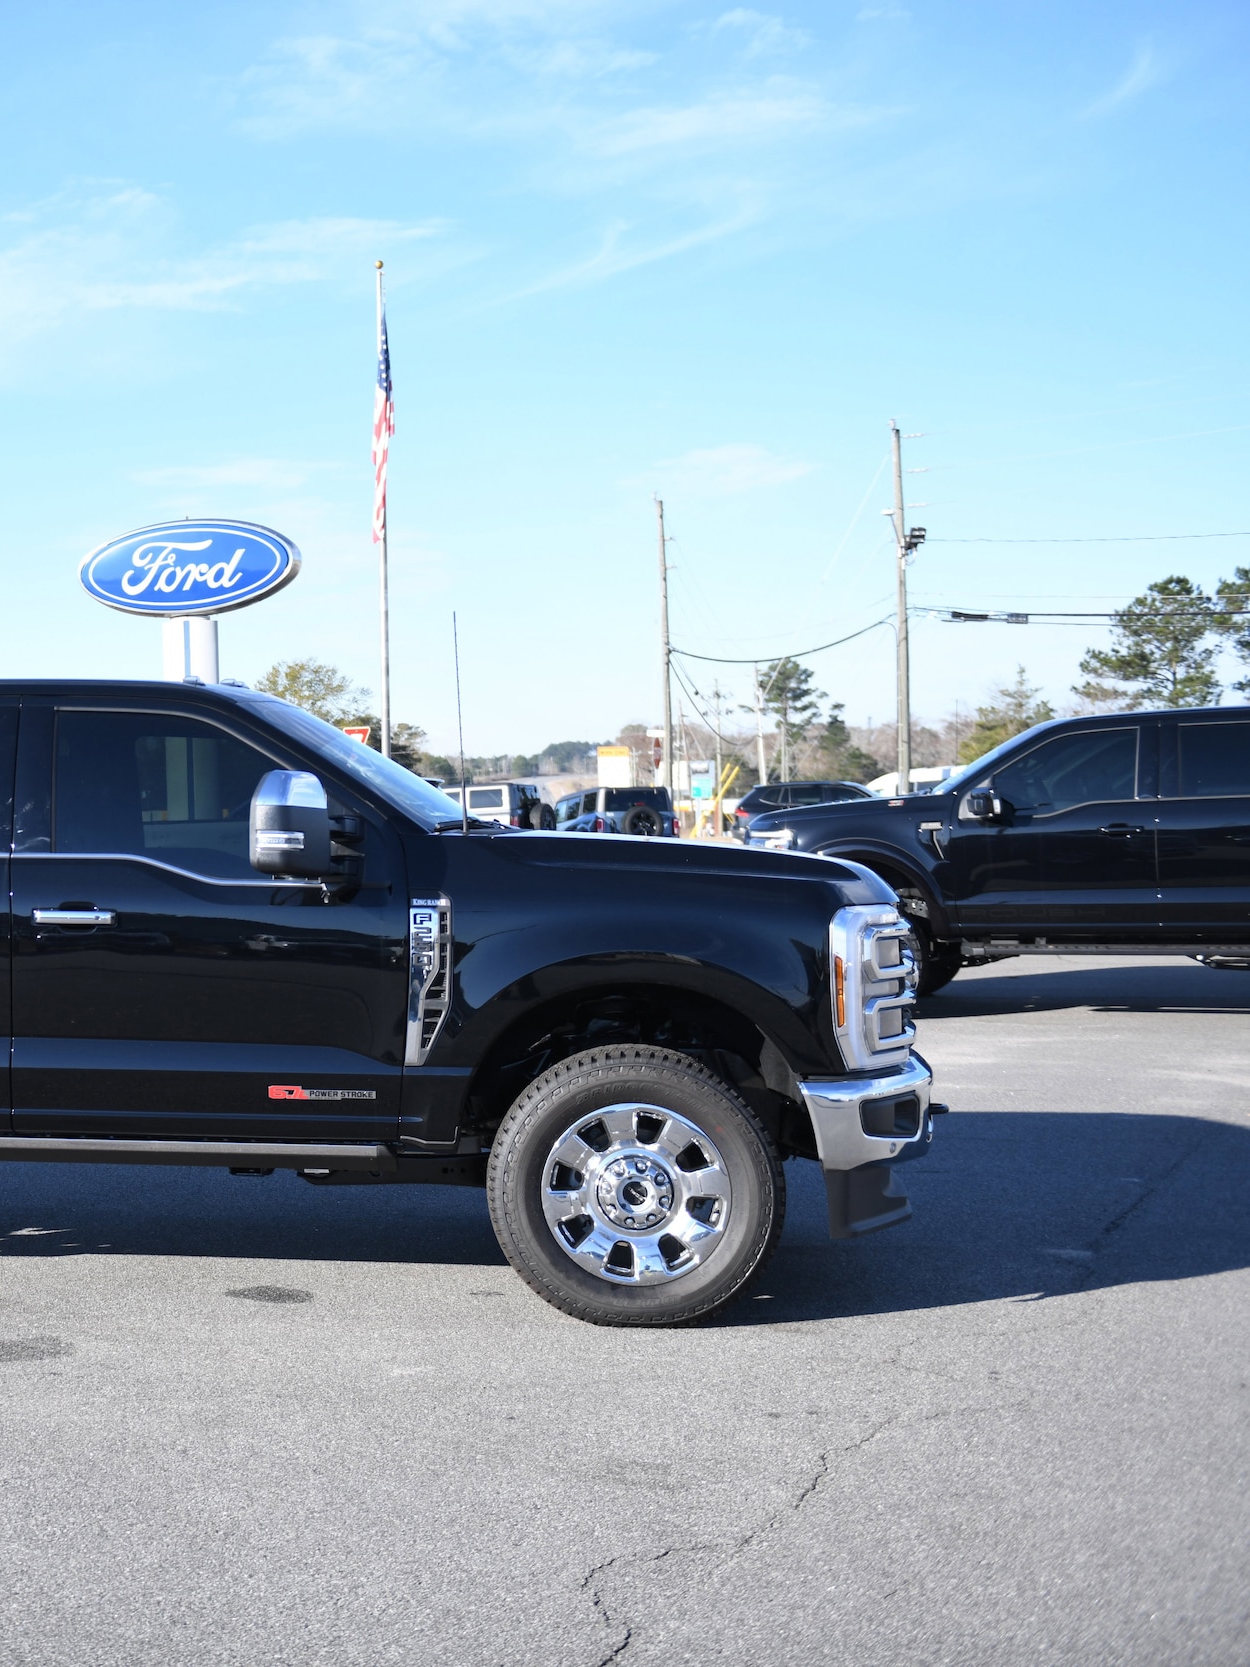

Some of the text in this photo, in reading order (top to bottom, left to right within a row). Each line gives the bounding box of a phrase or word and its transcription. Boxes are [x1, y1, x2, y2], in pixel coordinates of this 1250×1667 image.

[121, 539, 246, 595] Ford
[310, 1090, 339, 1098] POWER
[340, 1091, 374, 1099] STROKE
